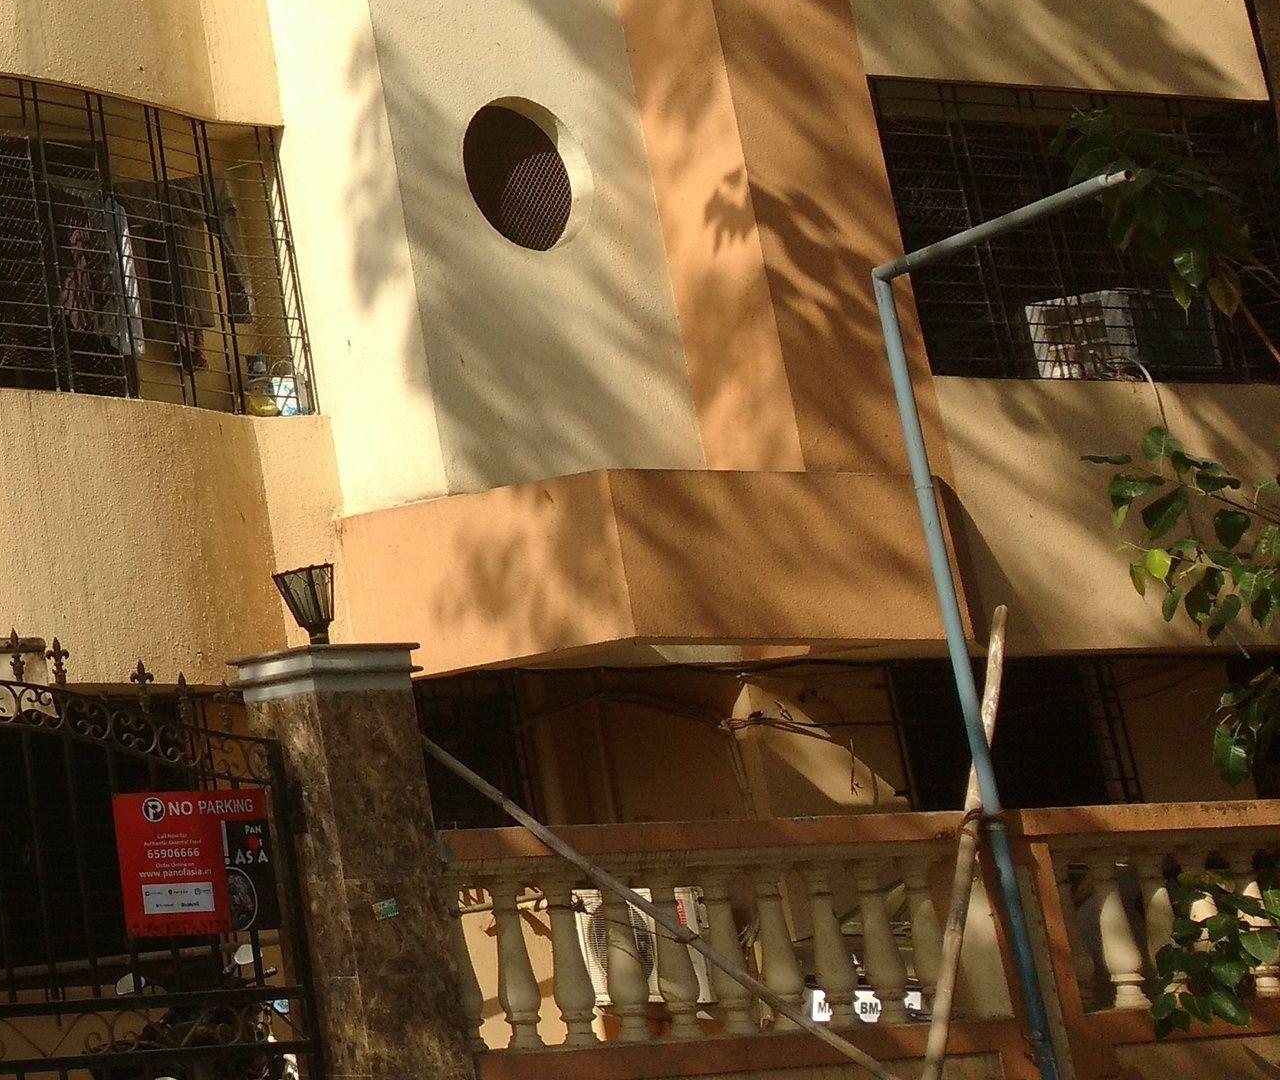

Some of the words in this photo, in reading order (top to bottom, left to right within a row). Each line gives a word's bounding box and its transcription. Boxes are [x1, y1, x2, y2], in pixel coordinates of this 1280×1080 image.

[168, 801, 194, 816] NO
[197, 798, 254, 814] PARKING
[244, 824, 262, 835] PAN
[147, 847, 200, 859] 65906666
